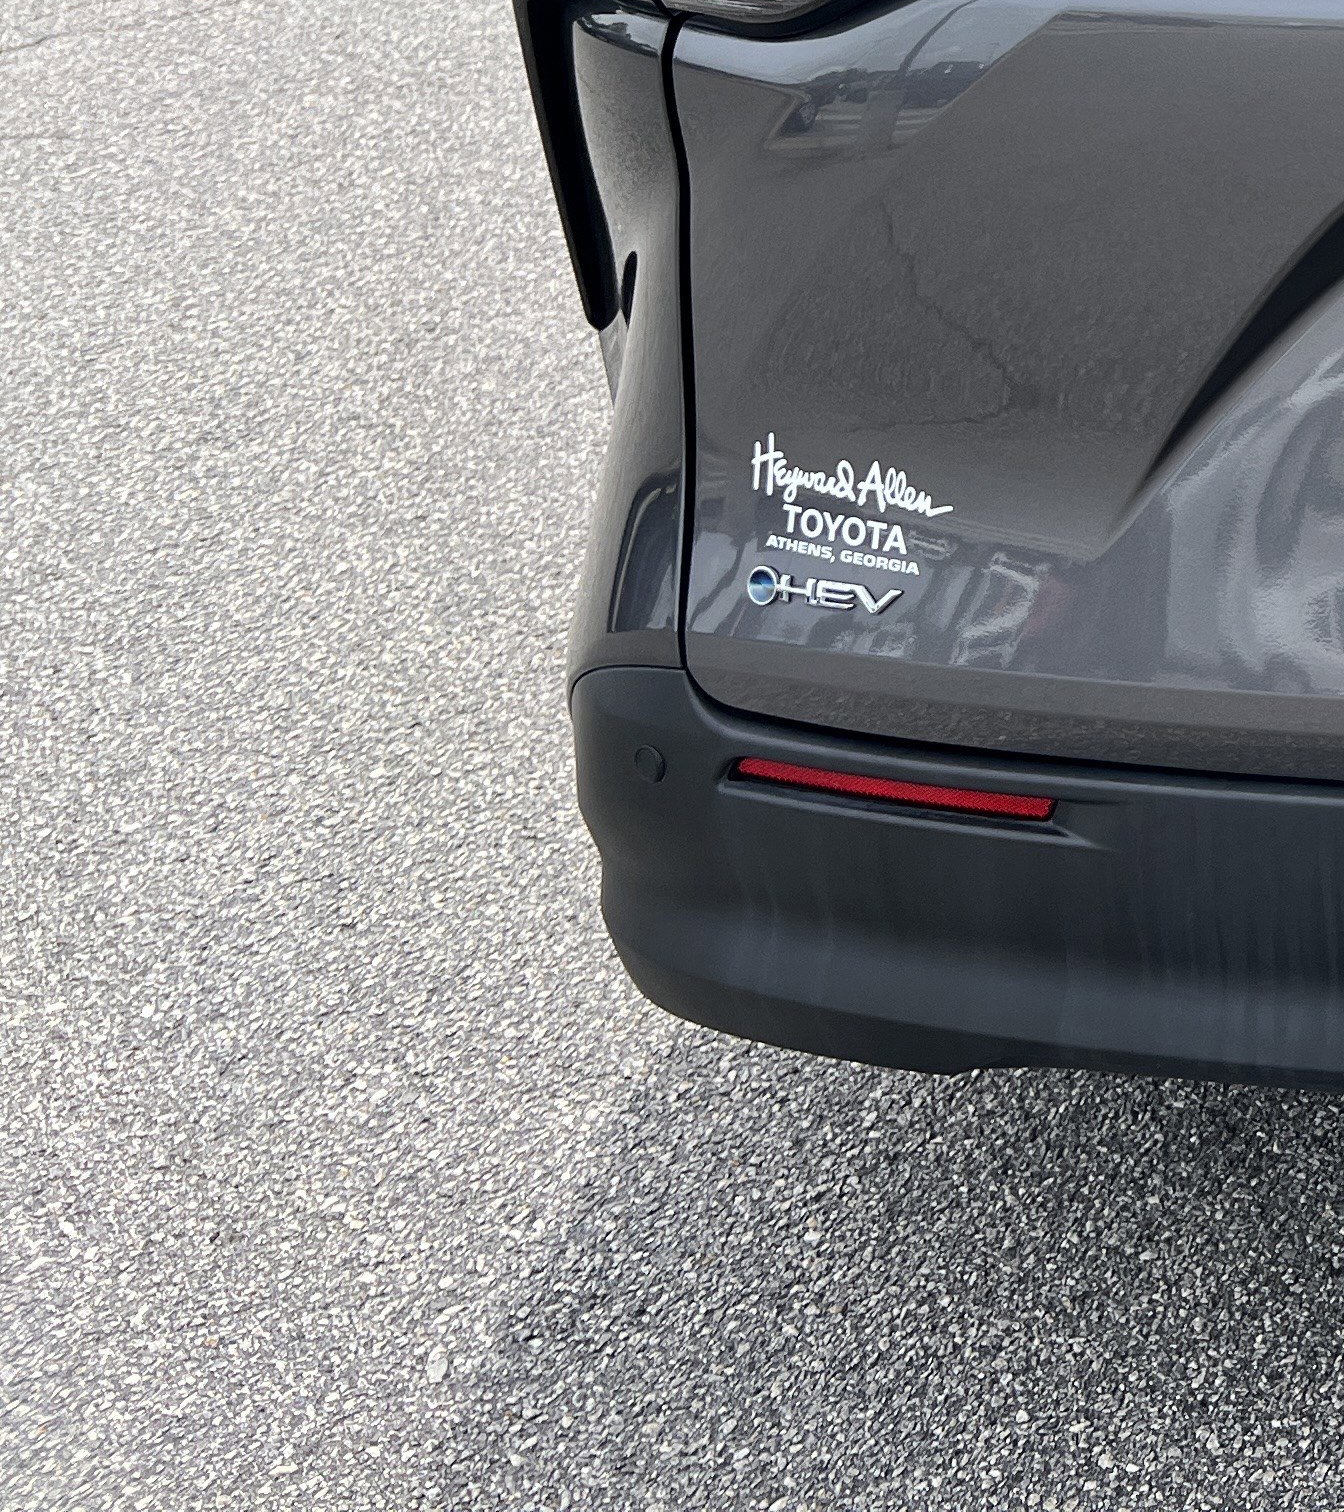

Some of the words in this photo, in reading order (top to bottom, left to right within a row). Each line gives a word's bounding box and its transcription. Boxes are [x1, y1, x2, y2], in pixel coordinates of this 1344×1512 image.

[751, 432, 856, 503] Heyward
[857, 460, 954, 518] Allen
[765, 534, 836, 564] ATHENS,
[839, 549, 920, 576] GEORGIA
[782, 503, 907, 555] TOYOTA
